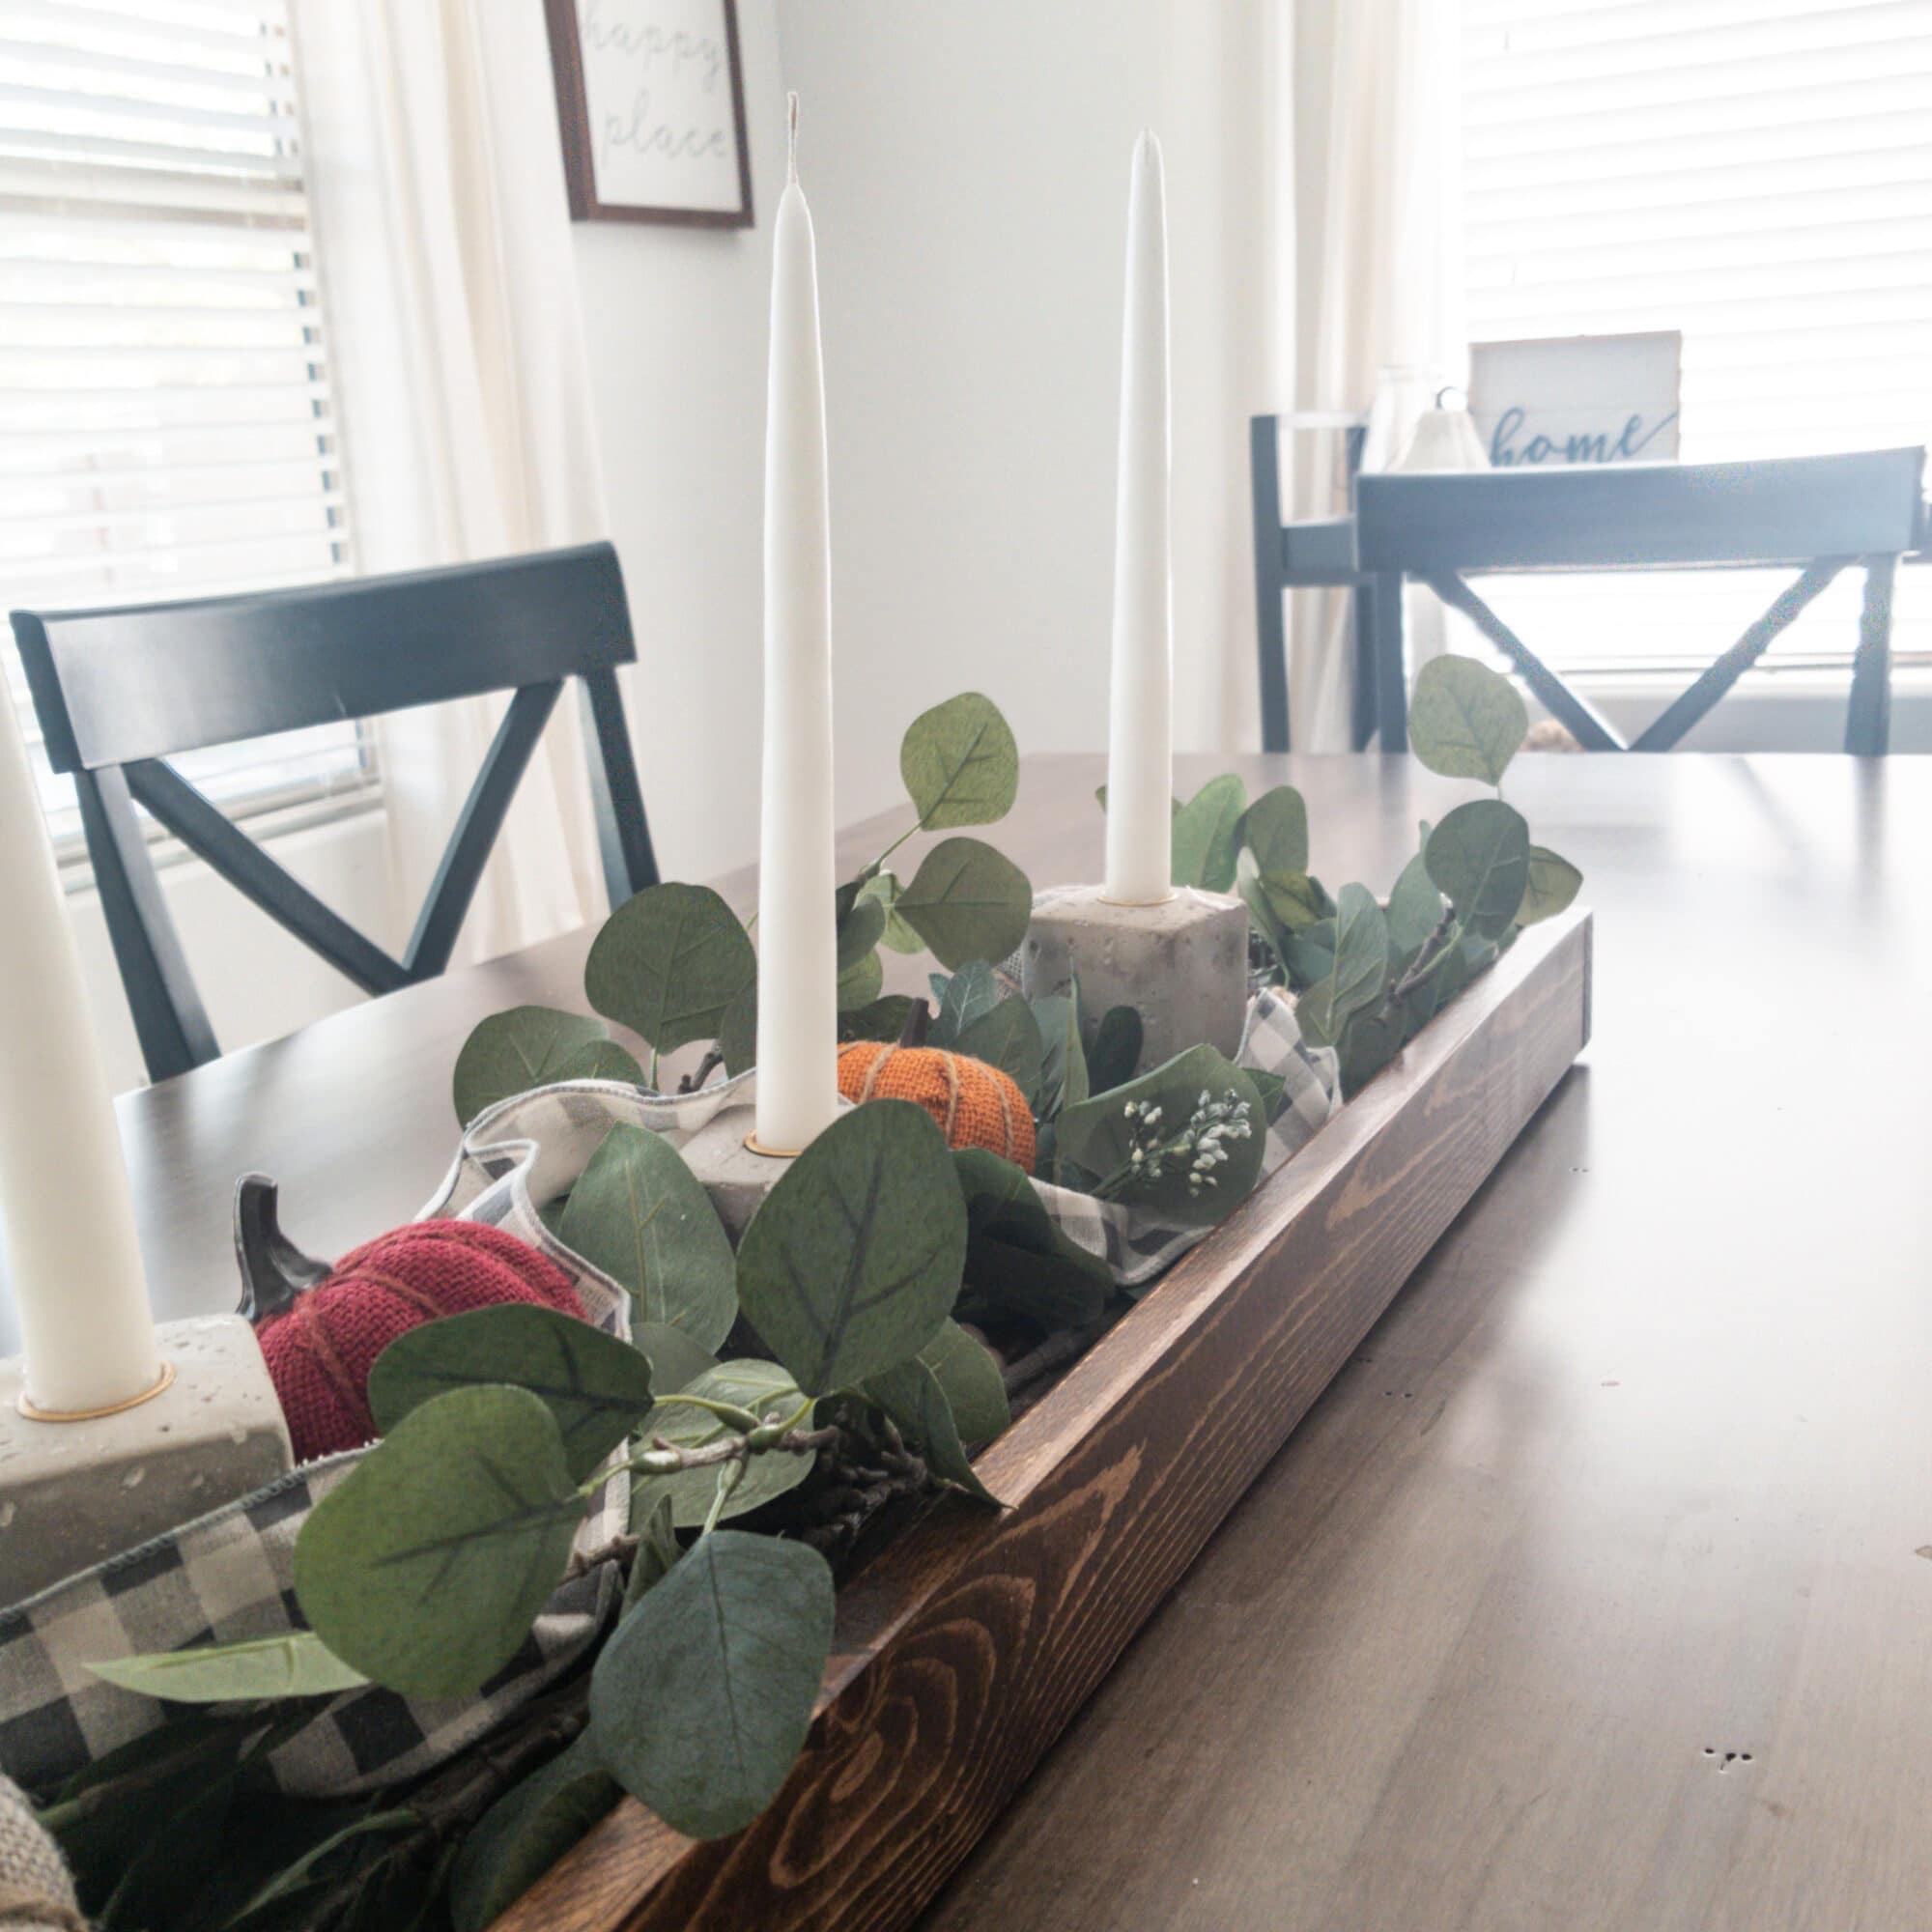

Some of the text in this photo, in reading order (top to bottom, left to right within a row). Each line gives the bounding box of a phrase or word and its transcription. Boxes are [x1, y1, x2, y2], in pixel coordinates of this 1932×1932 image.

[582, 0, 722, 93] happy
[601, 88, 727, 167] place
[1491, 406, 1677, 466] home
